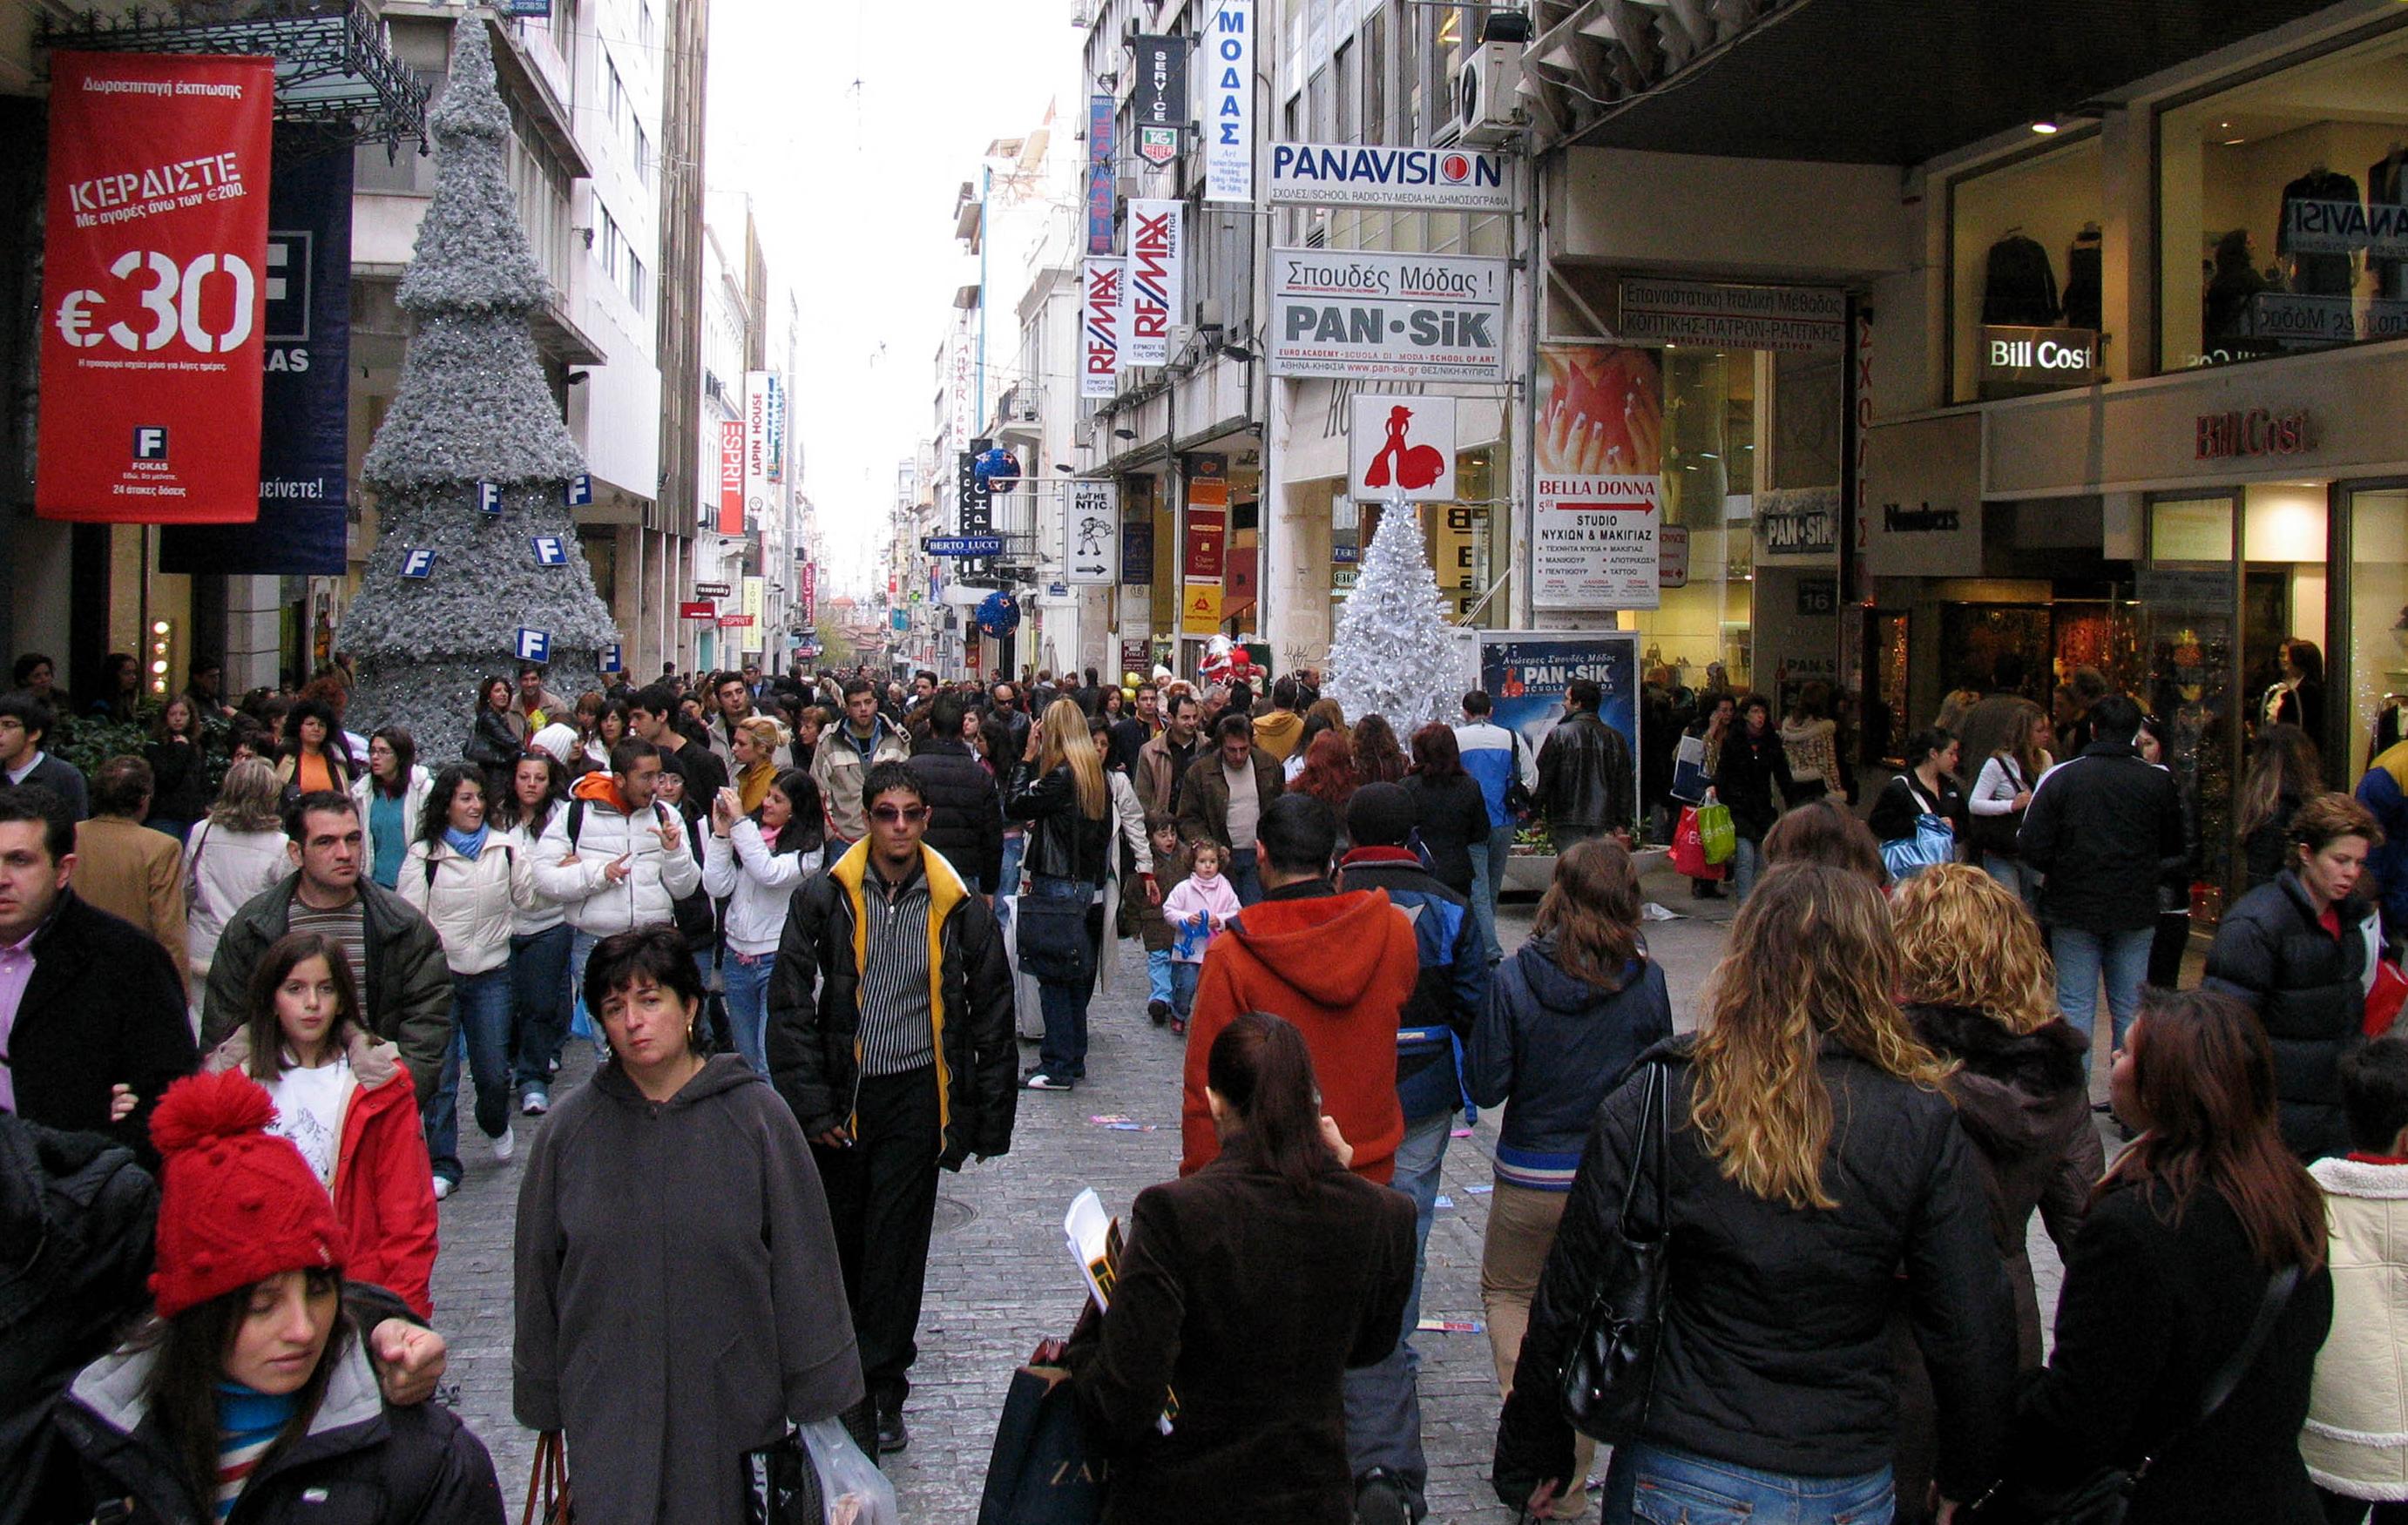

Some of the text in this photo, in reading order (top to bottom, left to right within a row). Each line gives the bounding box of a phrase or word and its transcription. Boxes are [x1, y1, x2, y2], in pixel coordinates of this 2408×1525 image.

[83, 77, 242, 99] Δωροεπιταγή έκπτωσης
[1153, 51, 1167, 122] SERVICE
[1145, 145, 1174, 159] HEUER
[1274, 145, 1502, 188] PANAVISION
[69, 152, 240, 213] ΚΕΡΔΙΣΤΕ
[76, 183, 247, 228] Με αγορές άνω των €200.
[1287, 261, 1390, 295] Σπουδές
[1400, 265, 1478, 299] Μόδας
[1302, 349, 1338, 358] ACADEMY
[1990, 341, 2093, 371] Bill Cost
[1348, 364, 1419, 375] www.pan-sik.gr
[140, 429, 162, 457] F
[751, 393, 762, 476] LAPIN HOUSE
[2195, 406, 2311, 461] Bill Cost
[722, 424, 741, 496] ESPRIT
[112, 484, 186, 497] 24 άτοκες δόσεις
[483, 482, 498, 510] F
[569, 476, 586, 505] F
[1539, 480, 1655, 496] BELLA DONNA
[1577, 515, 1617, 526] STUDIO
[929, 540, 998, 550] BERTO LUCCI
[1541, 530, 1586, 541] ΝΥΧΙΩΝ
[1588, 530, 1595, 540] &
[1600, 530, 1653, 541] ΜΑΚΙΓΙΑΖ
[404, 550, 430, 575] F
[538, 539, 559, 563] F
[1803, 593, 1830, 610] 16
[721, 616, 752, 625] ESPRIT
[522, 630, 544, 658] F
[599, 644, 616, 672] F
[1547, 654, 1585, 664] Σπουδές
[1525, 685, 1565, 693] SCUOLA
